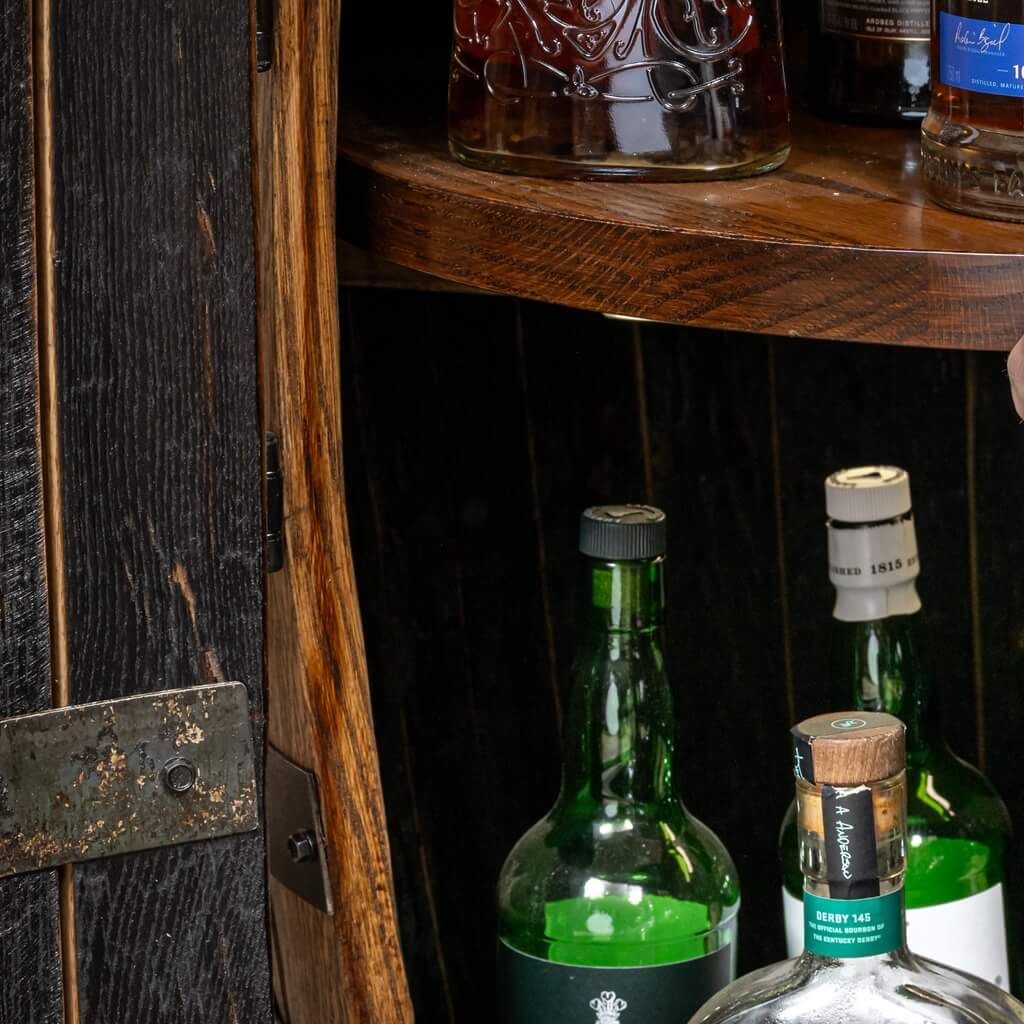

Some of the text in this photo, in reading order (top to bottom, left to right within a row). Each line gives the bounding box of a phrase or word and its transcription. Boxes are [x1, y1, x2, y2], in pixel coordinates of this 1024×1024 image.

[871, 558, 902, 575] 1815
[816, 910, 872, 924] DERBY 145
